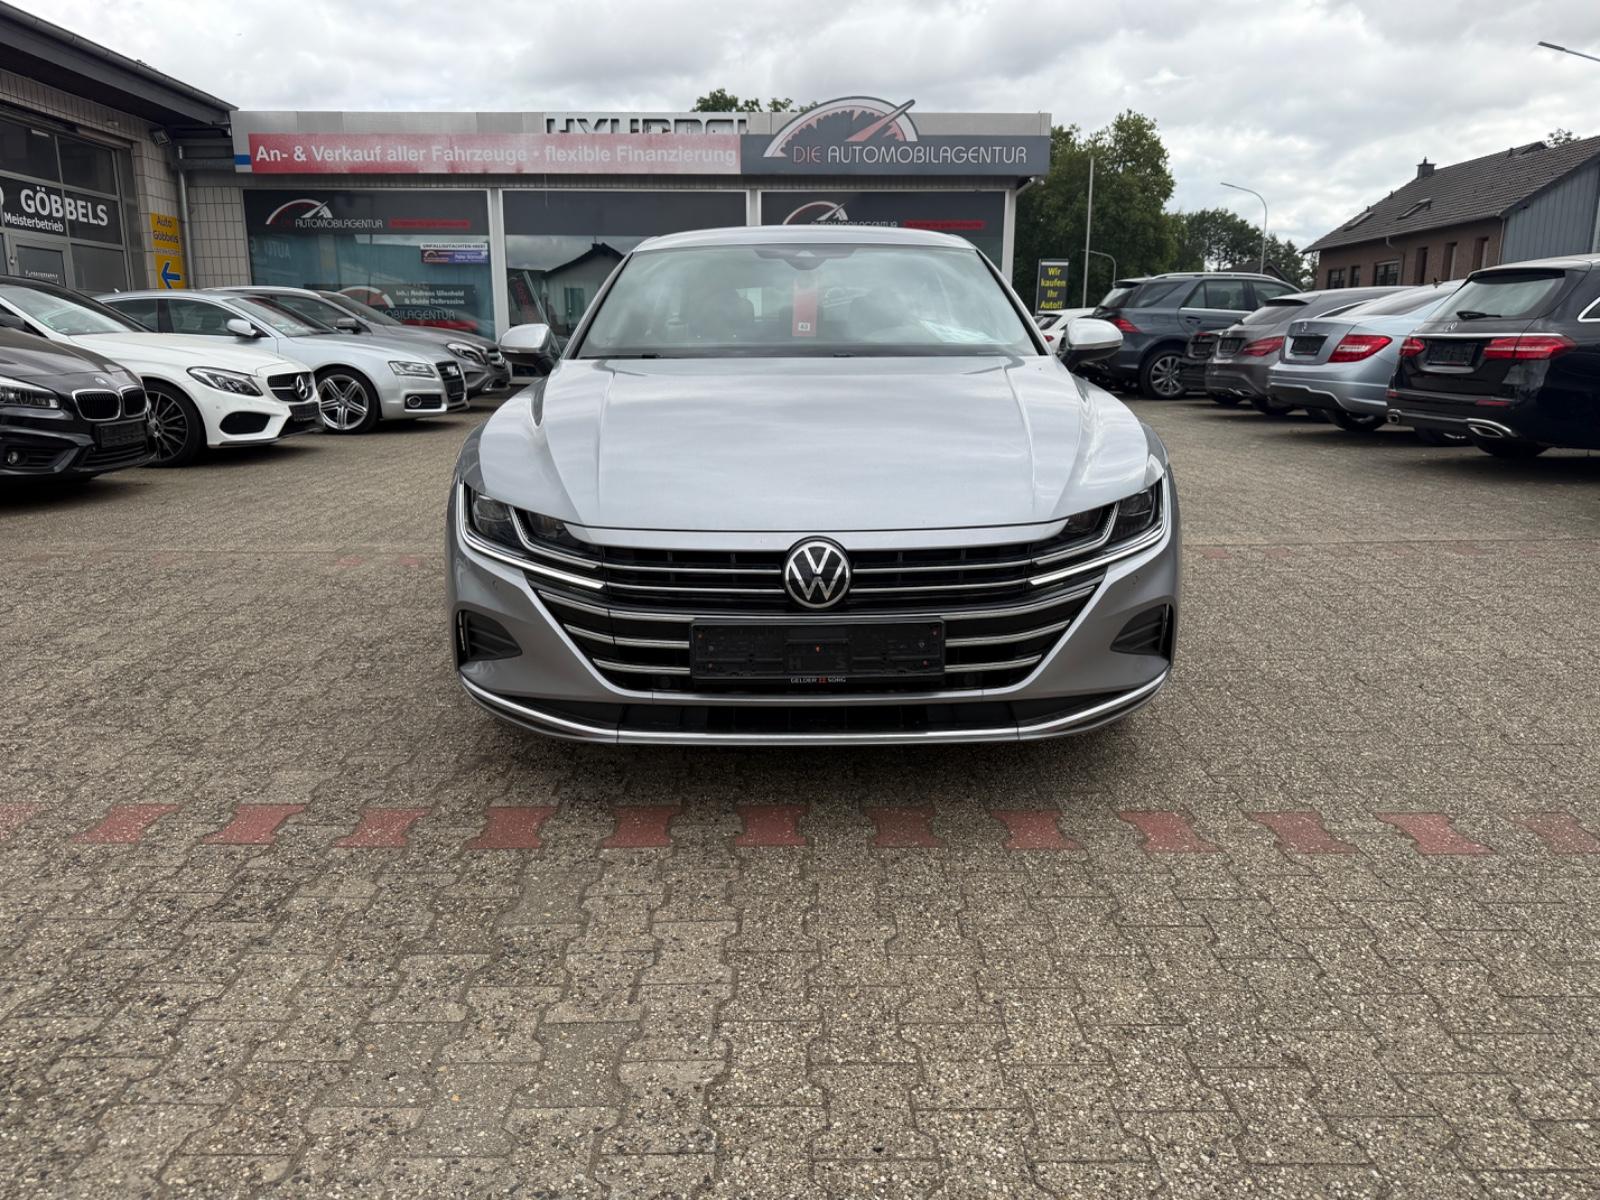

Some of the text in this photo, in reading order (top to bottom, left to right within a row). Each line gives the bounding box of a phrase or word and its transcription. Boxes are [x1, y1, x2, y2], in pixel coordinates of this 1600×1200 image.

[255, 145, 736, 166] An- & Verkauf aller Fahrzeuge flexible Finanzierung
[793, 146, 1027, 164] DIE AUTOMOBILAGENTUR
[20, 186, 109, 226] GÖBBELS
[4, 211, 64, 232] Meisterbetrieb
[295, 218, 383, 229] AUTOMOBILAGENTUR
[1048, 267, 1061, 276] Wir
